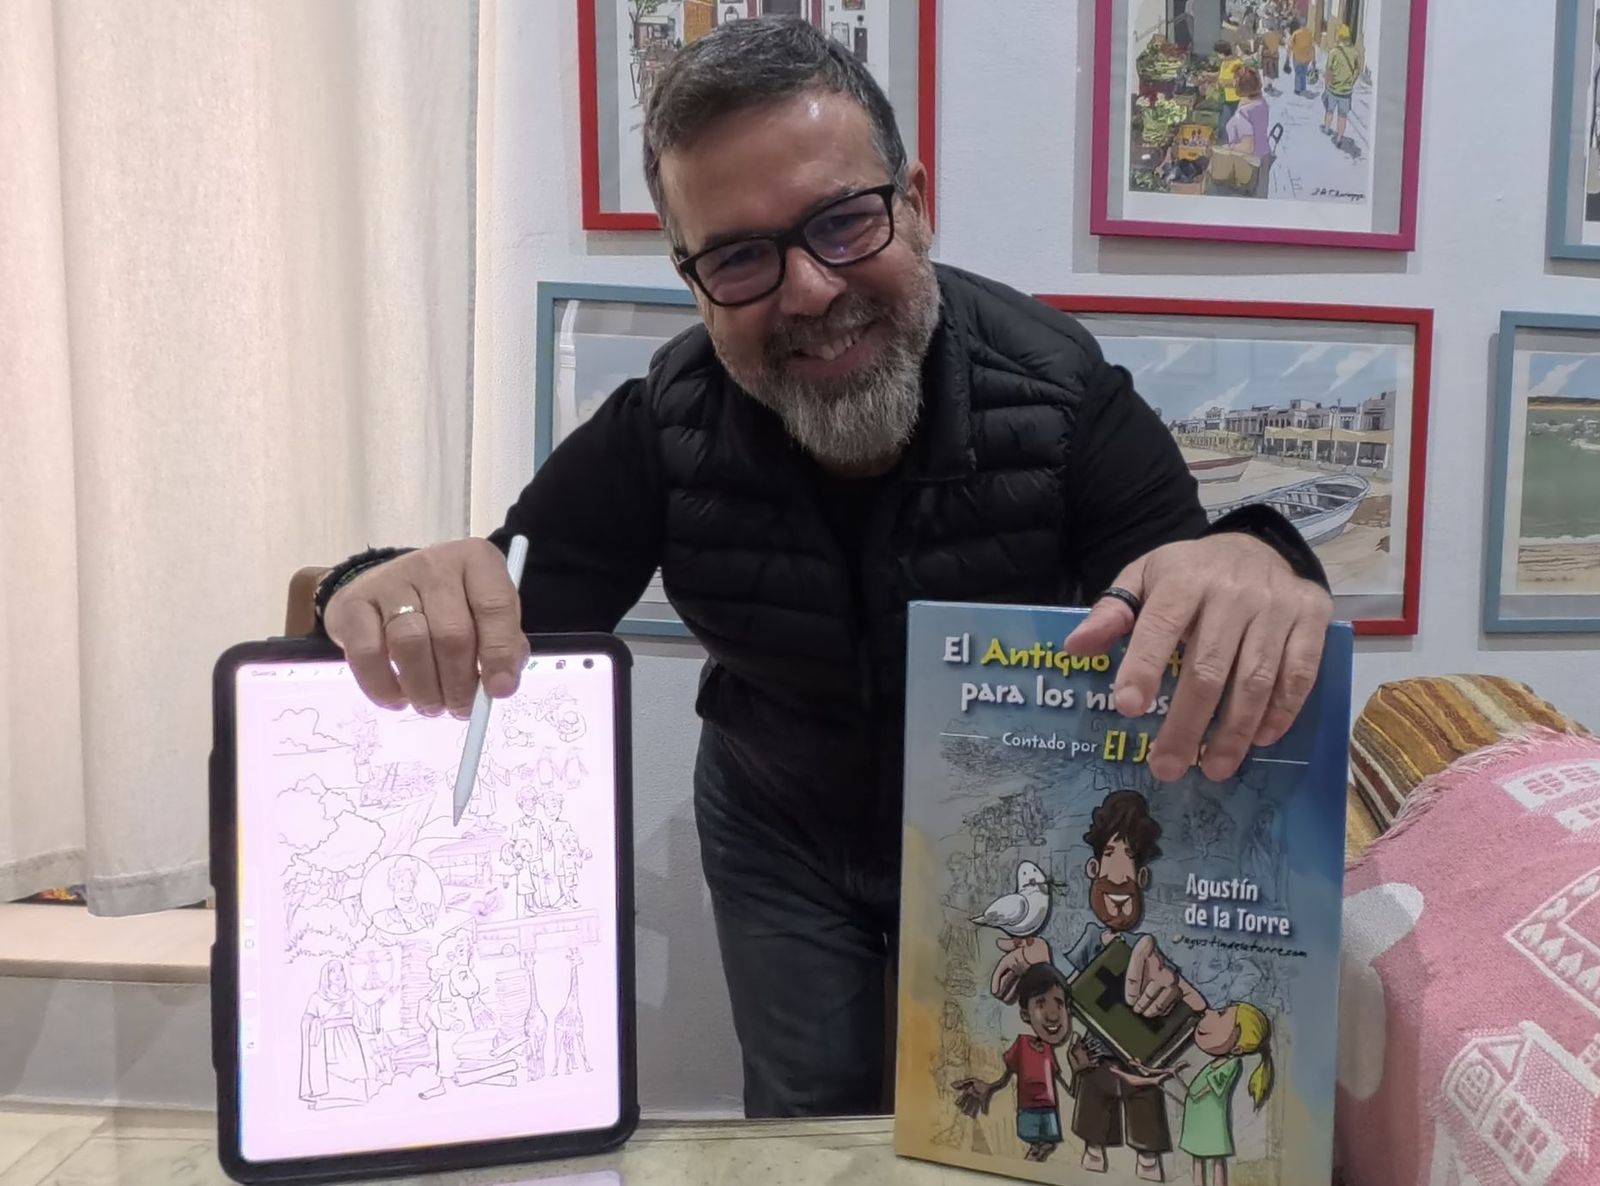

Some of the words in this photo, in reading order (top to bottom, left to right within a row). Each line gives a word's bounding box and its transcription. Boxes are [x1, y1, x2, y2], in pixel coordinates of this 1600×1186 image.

[943, 632, 970, 664] El
[980, 638, 1111, 677] Antiguo
[961, 682, 1025, 712] para
[1036, 675, 1075, 709] los
[1086, 683, 1169, 717] nis
[1002, 732, 1066, 751] Contado
[1071, 740, 1098, 758] por
[1103, 729, 1127, 762] El
[1186, 872, 1258, 902] Agustín
[1184, 904, 1208, 926] de
[1213, 906, 1230, 929] la
[1236, 908, 1290, 936] Torre
